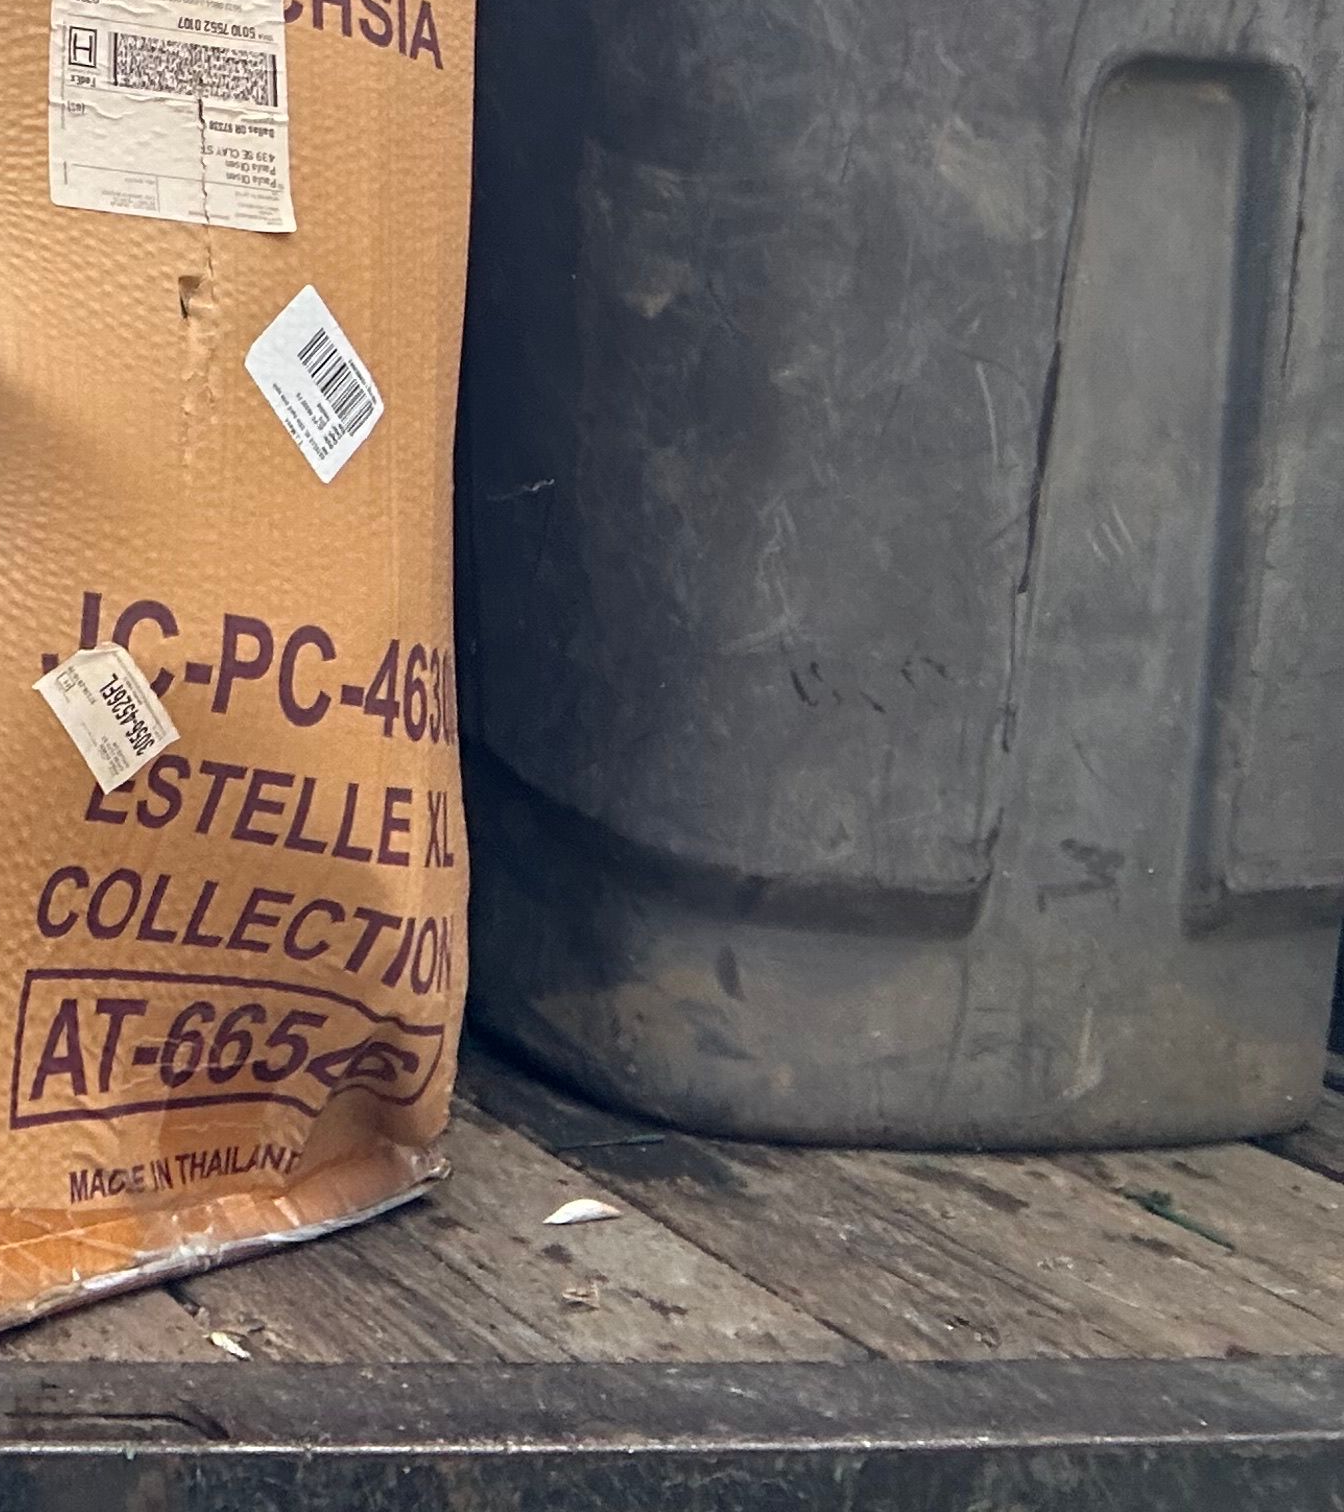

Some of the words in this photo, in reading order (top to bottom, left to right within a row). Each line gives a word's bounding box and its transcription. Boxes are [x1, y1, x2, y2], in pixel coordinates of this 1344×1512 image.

[231, 25, 256, 40] 5010
[85, 753, 414, 867] ESTELLE
[424, 790, 455, 868] XL
[36, 865, 453, 996] COLLECTION
[68, 1164, 146, 1205] MADE
[150, 1156, 174, 1190] IN
